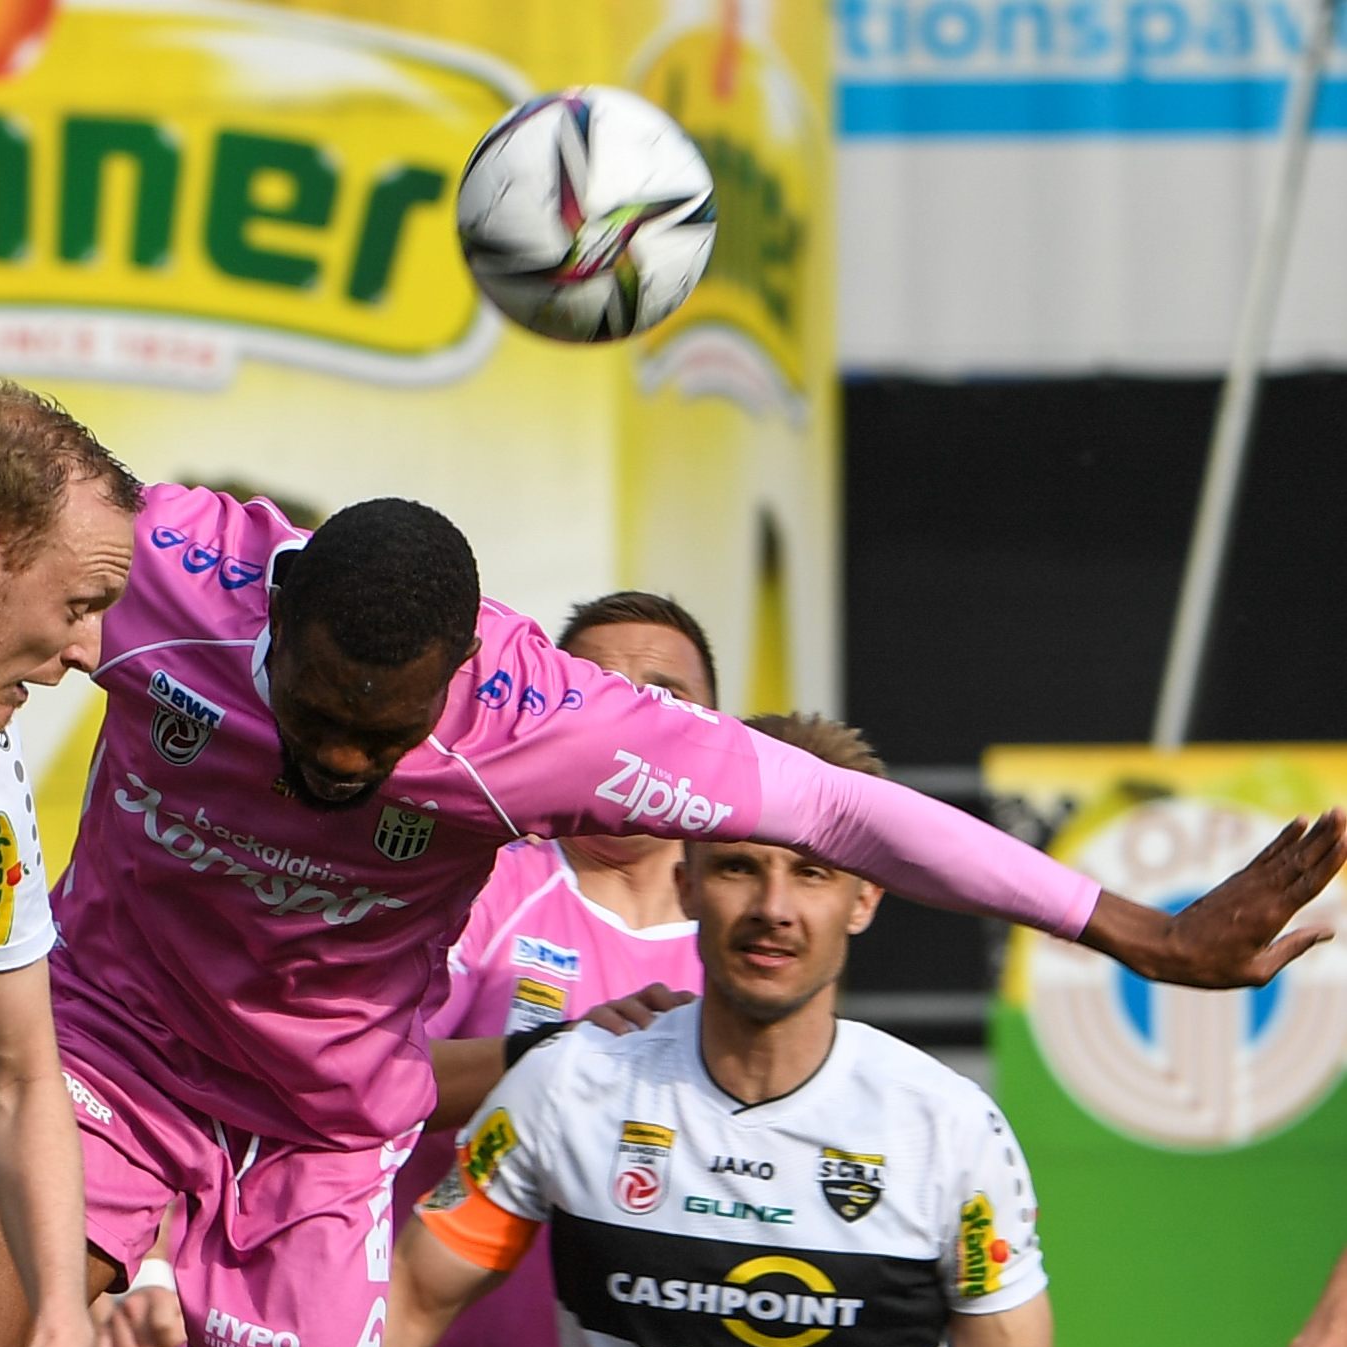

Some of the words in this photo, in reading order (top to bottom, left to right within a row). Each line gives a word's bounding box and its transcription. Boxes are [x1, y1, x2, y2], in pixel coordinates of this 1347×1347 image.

[171, 688, 219, 727] BWT
[594, 749, 733, 833] Zipfer
[383, 819, 430, 837] LASK
[194, 807, 346, 884] backaldrin
[709, 1156, 775, 1181] JAKO
[820, 1158, 882, 1184] SCRA
[684, 1196, 794, 1225] GUNZ
[606, 1273, 864, 1328] CASHPOINT
